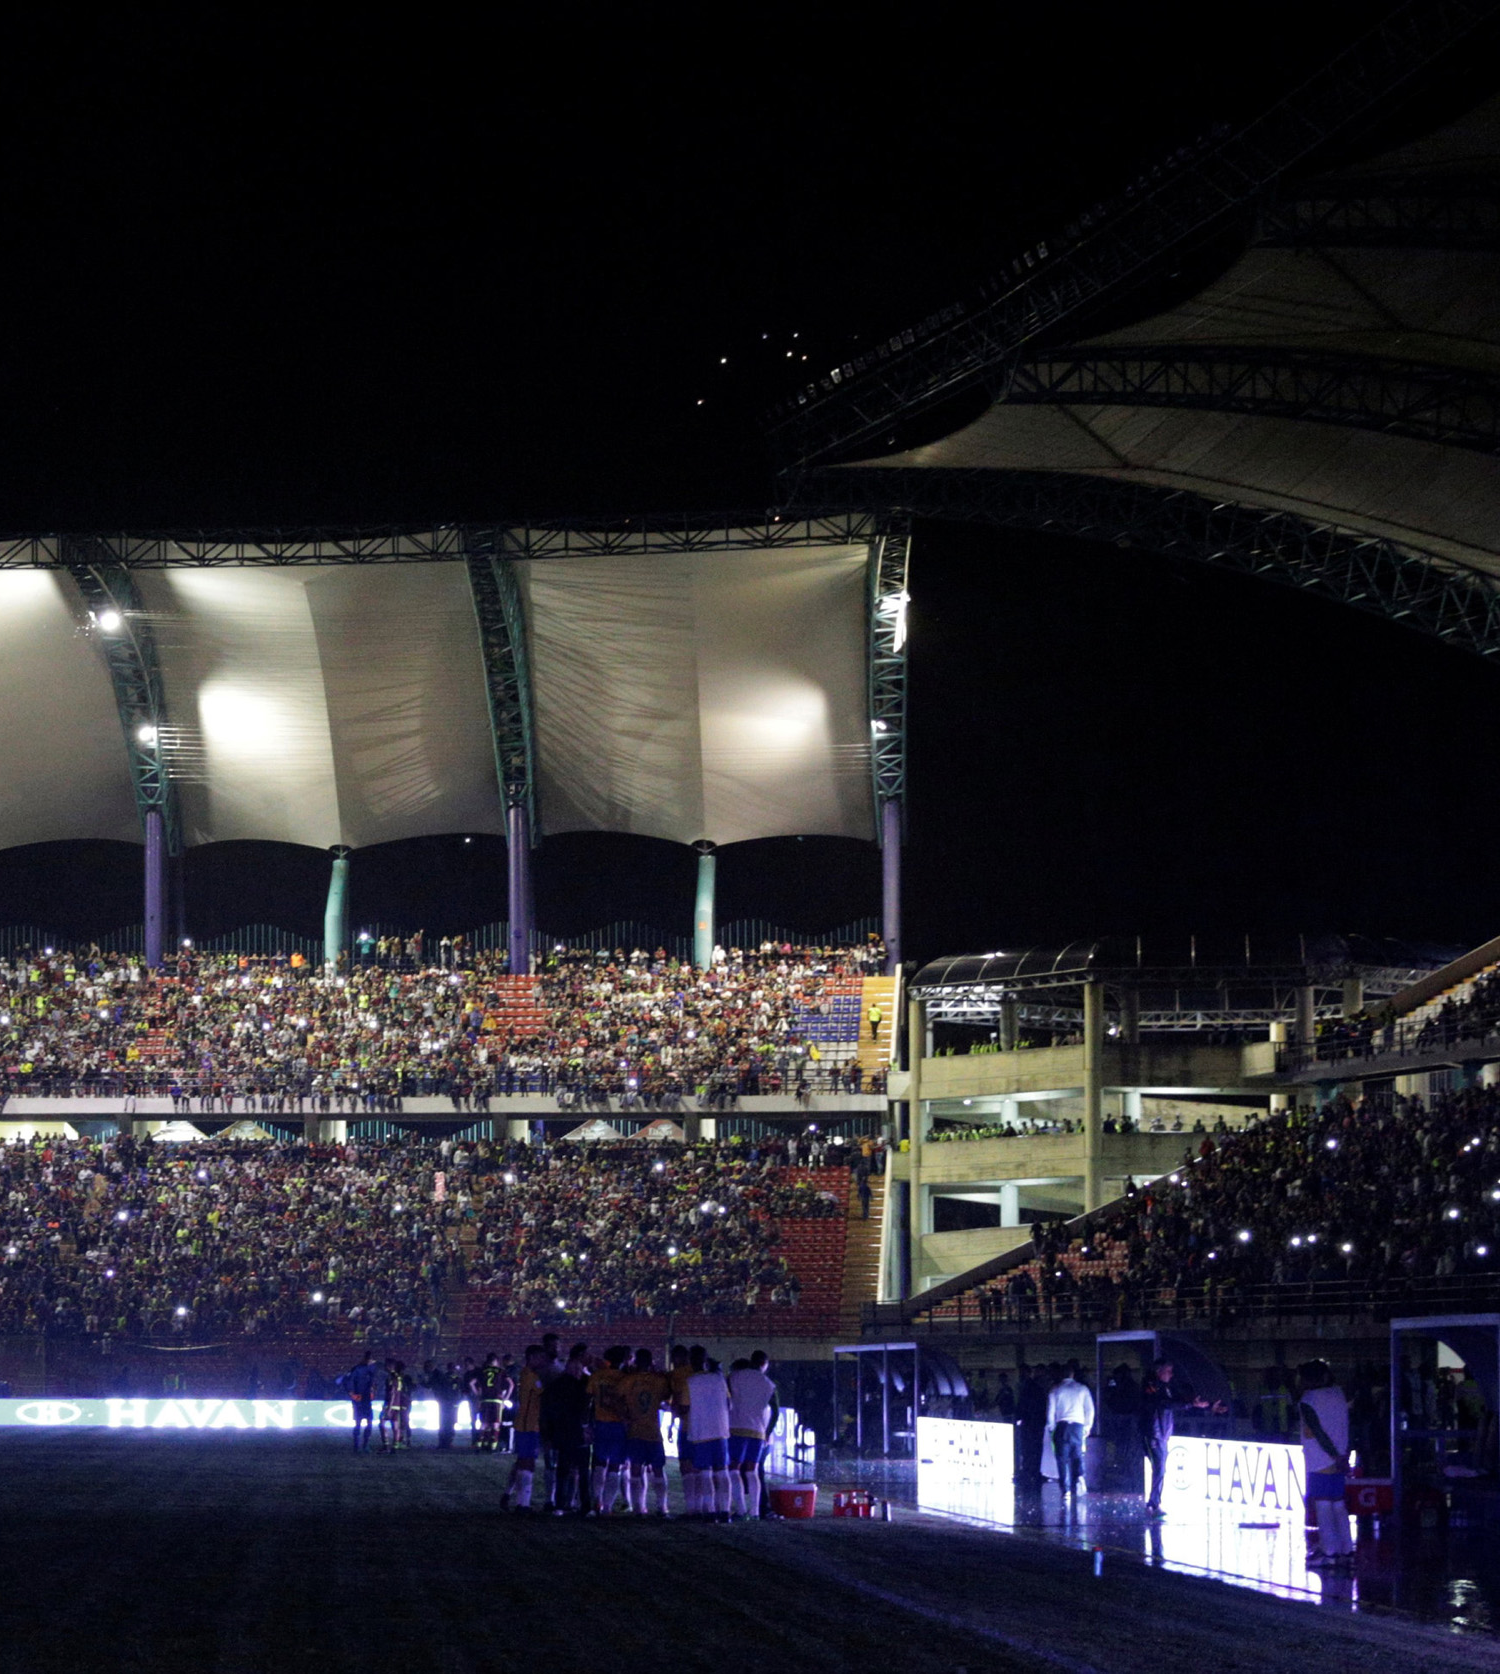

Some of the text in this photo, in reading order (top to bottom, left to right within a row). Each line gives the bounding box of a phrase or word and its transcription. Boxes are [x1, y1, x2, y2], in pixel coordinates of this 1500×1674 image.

[486, 1371, 496, 1388] 2
[105, 1398, 298, 1429] HAVAN
[1204, 1442, 1307, 1512] HAVAN
